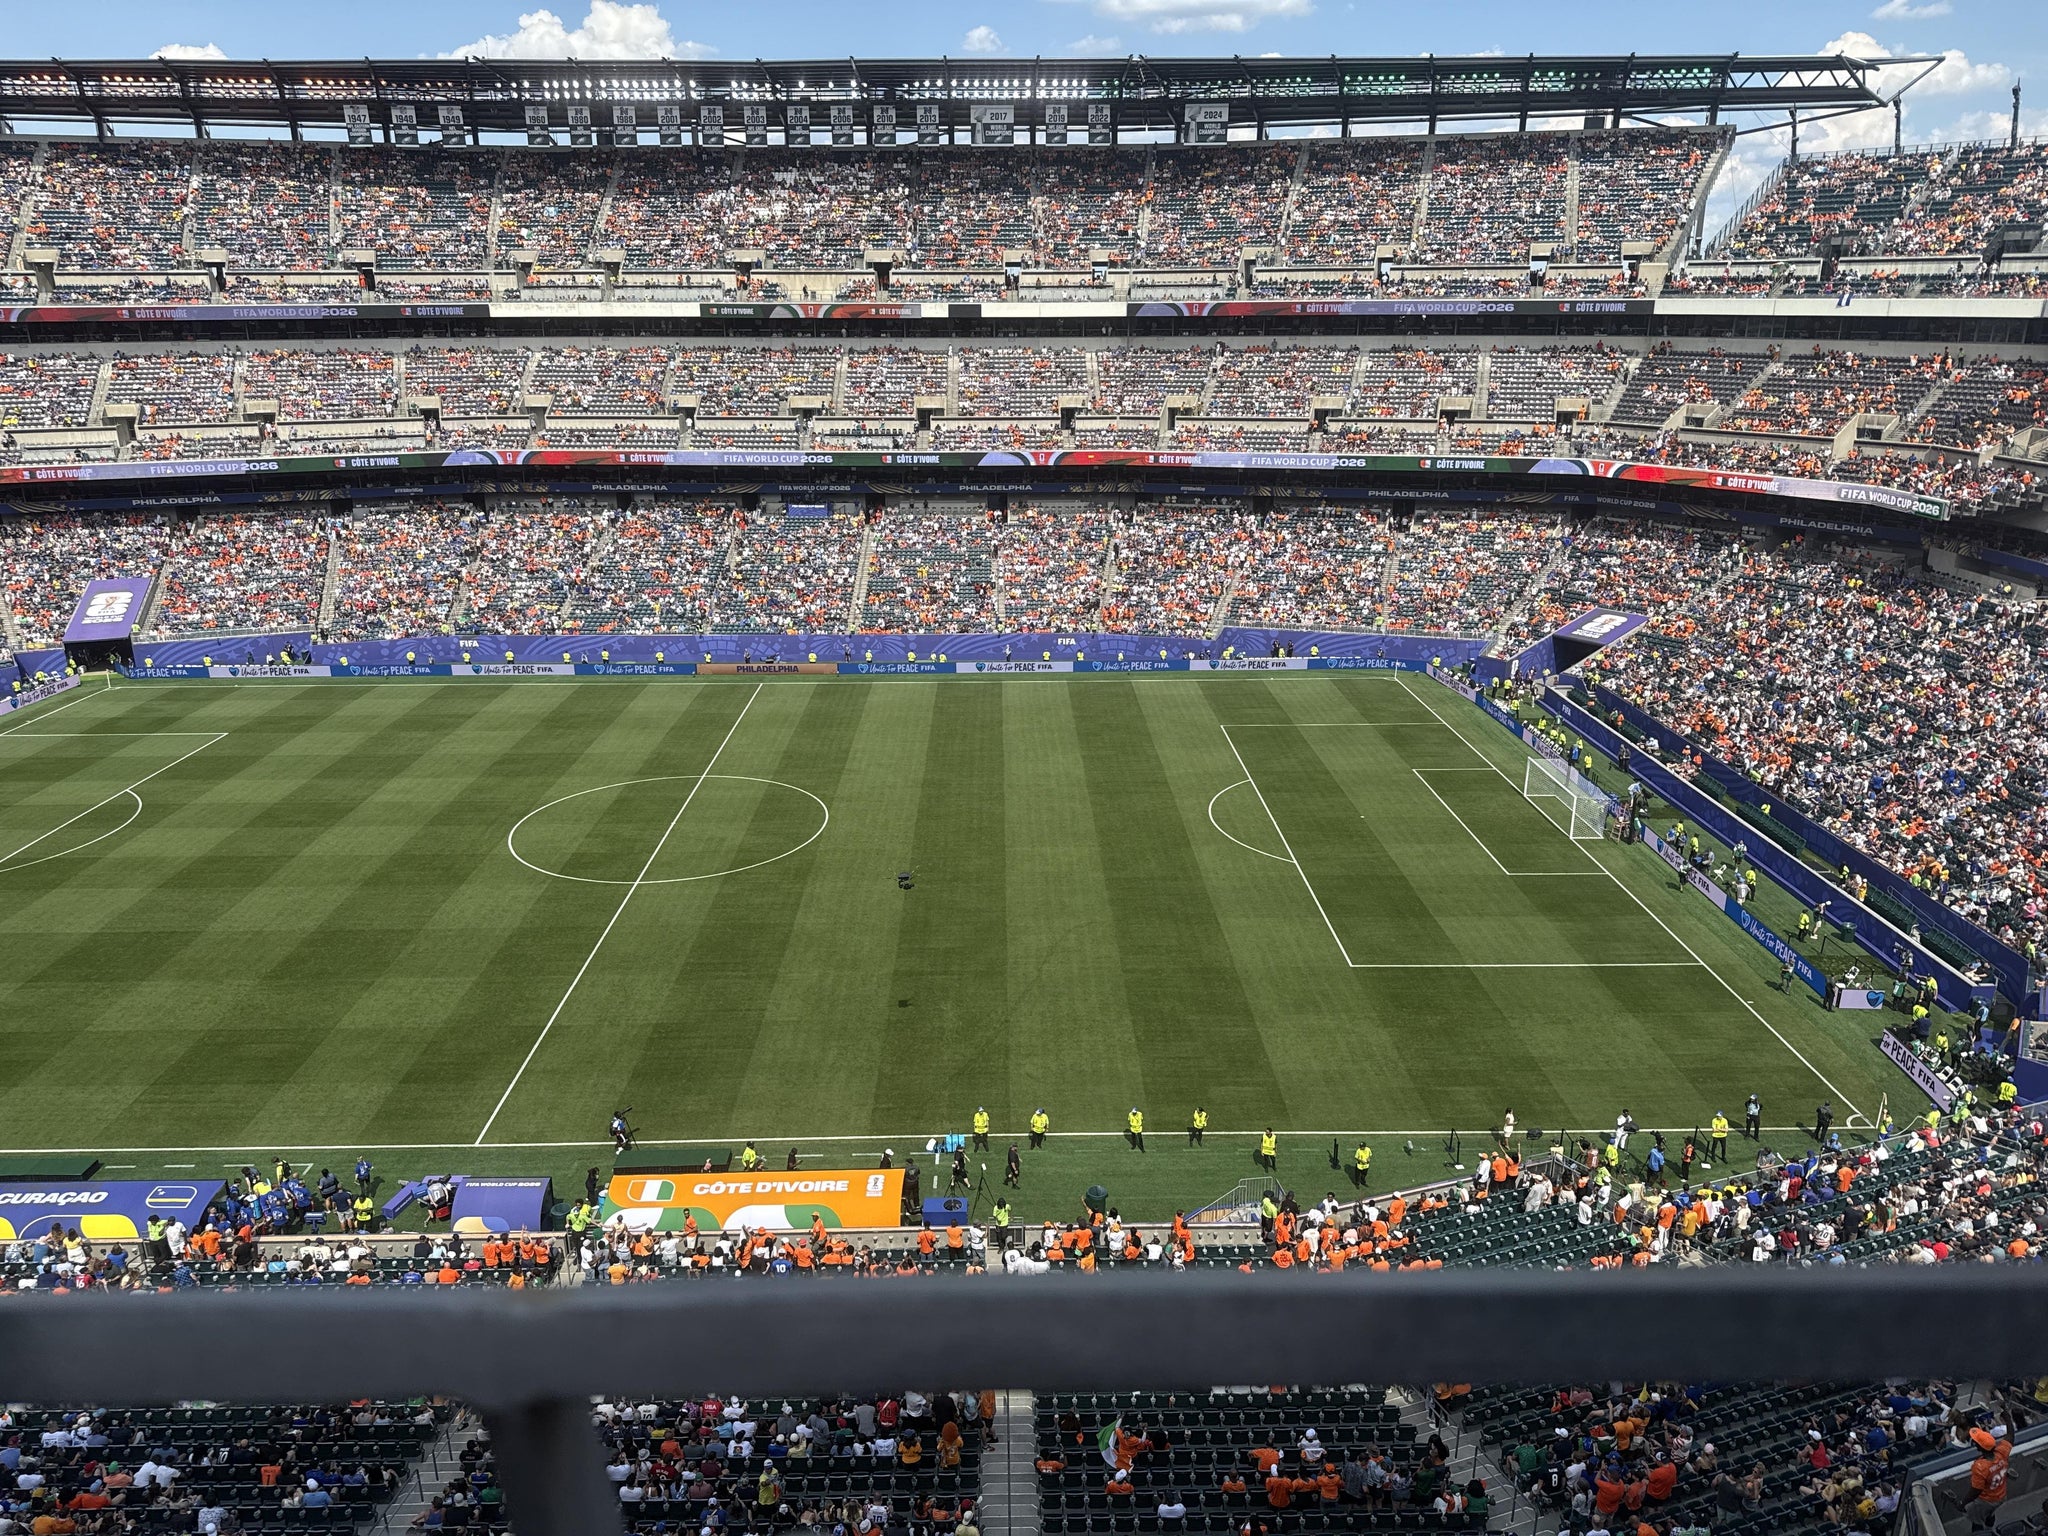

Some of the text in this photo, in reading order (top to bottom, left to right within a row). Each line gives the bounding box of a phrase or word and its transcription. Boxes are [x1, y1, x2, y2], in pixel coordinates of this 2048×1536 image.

[347, 114, 367, 123] 1947
[395, 115, 414, 123] 1948
[442, 115, 461, 123] 1949
[789, 115, 808, 123] 2004
[833, 115, 851, 123] 2006
[876, 115, 894, 123] 2010
[919, 114, 937, 122] 2013
[990, 113, 1007, 121] 2017
[1048, 114, 1065, 122] 2019
[1090, 114, 1108, 122] 2022
[1204, 111, 1222, 119] 2024
[528, 116, 546, 124] 1960
[571, 116, 589, 124] 1980
[616, 116, 634, 124] 1988
[417, 306, 464, 315] CÔTE D'IVOIRE
[721, 307, 732, 315] CÔTE
[1306, 303, 1352, 312] CÔTE D'IVOIRE
[1394, 303, 1514, 311] FIFA WORLD CUP 2026
[1576, 302, 1626, 311] CÔTE D'IVOIRE
[135, 309, 187, 318] CÔTE D'IVOIRE
[233, 309, 257, 317] FIFA
[259, 309, 296, 317] WORLD
[321, 308, 358, 316] 2026
[351, 457, 399, 467] CÔTE D'IVOIRE
[630, 453, 674, 462] CÔTE D'IVOIRE
[724, 455, 833, 463] FIFA WORLD CUP 2026
[896, 454, 940, 463] CÔTE D'IVOIRE
[1159, 454, 1202, 464] CÔTE D'IVOIRE
[1251, 457, 1366, 467] FIFA WORLD CUP 2026
[150, 462, 279, 474] FIFA WORLD CUP 2026
[1436, 459, 1485, 469] CÔTE D'IVOIRE
[36, 469, 91, 479] CÔTE D'IVOIRE
[1728, 477, 1780, 491] CÔTE D'IVOIRE
[1368, 490, 1449, 498] PHILADELPHIA
[132, 496, 221, 505] PHILADELPHIA
[1596, 496, 1619, 504] WORLD
[1633, 500, 1656, 508] 2026
[1840, 489, 1940, 516] FIFA WORLD CUP 2026
[1780, 517, 1873, 534] PHILADELPHIA
[1003, 663, 1013, 671] For
[1014, 663, 1035, 671] PEACE
[1120, 662, 1130, 670] For
[1131, 662, 1152, 670] PEACE
[1237, 661, 1246, 669] For
[1248, 661, 1269, 669] PEACE
[1367, 659, 1388, 667] PEACE
[259, 667, 269, 675] For
[269, 667, 292, 675] PEACE
[380, 667, 390, 675] For
[390, 666, 413, 674] PEACE
[501, 665, 512, 674] For
[513, 665, 535, 674] PEACE
[623, 665, 634, 674] For
[635, 665, 657, 674] PEACE
[886, 664, 897, 672] For
[897, 664, 918, 672] PEACE
[146, 668, 170, 678] PEACE
[40, 684, 57, 698] PEACE
[57, 682, 69, 690] FIFA
[1698, 877, 1709, 892] FIFA
[1765, 932, 1775, 948] For
[1775, 940, 1797, 963] PEACE
[1798, 961, 1812, 980] FIFA
[1881, 1032, 1936, 1094] For PEACE FIFA
[693, 1180, 849, 1194] CÔTE D'IVOIRE
[0, 1192, 109, 1205] CURAÇAO
[776, 1264, 786, 1272] 10
[76, 1279, 85, 1288] 16
[219, 1452, 228, 1464] 10
[1552, 1474, 1558, 1487] 8
